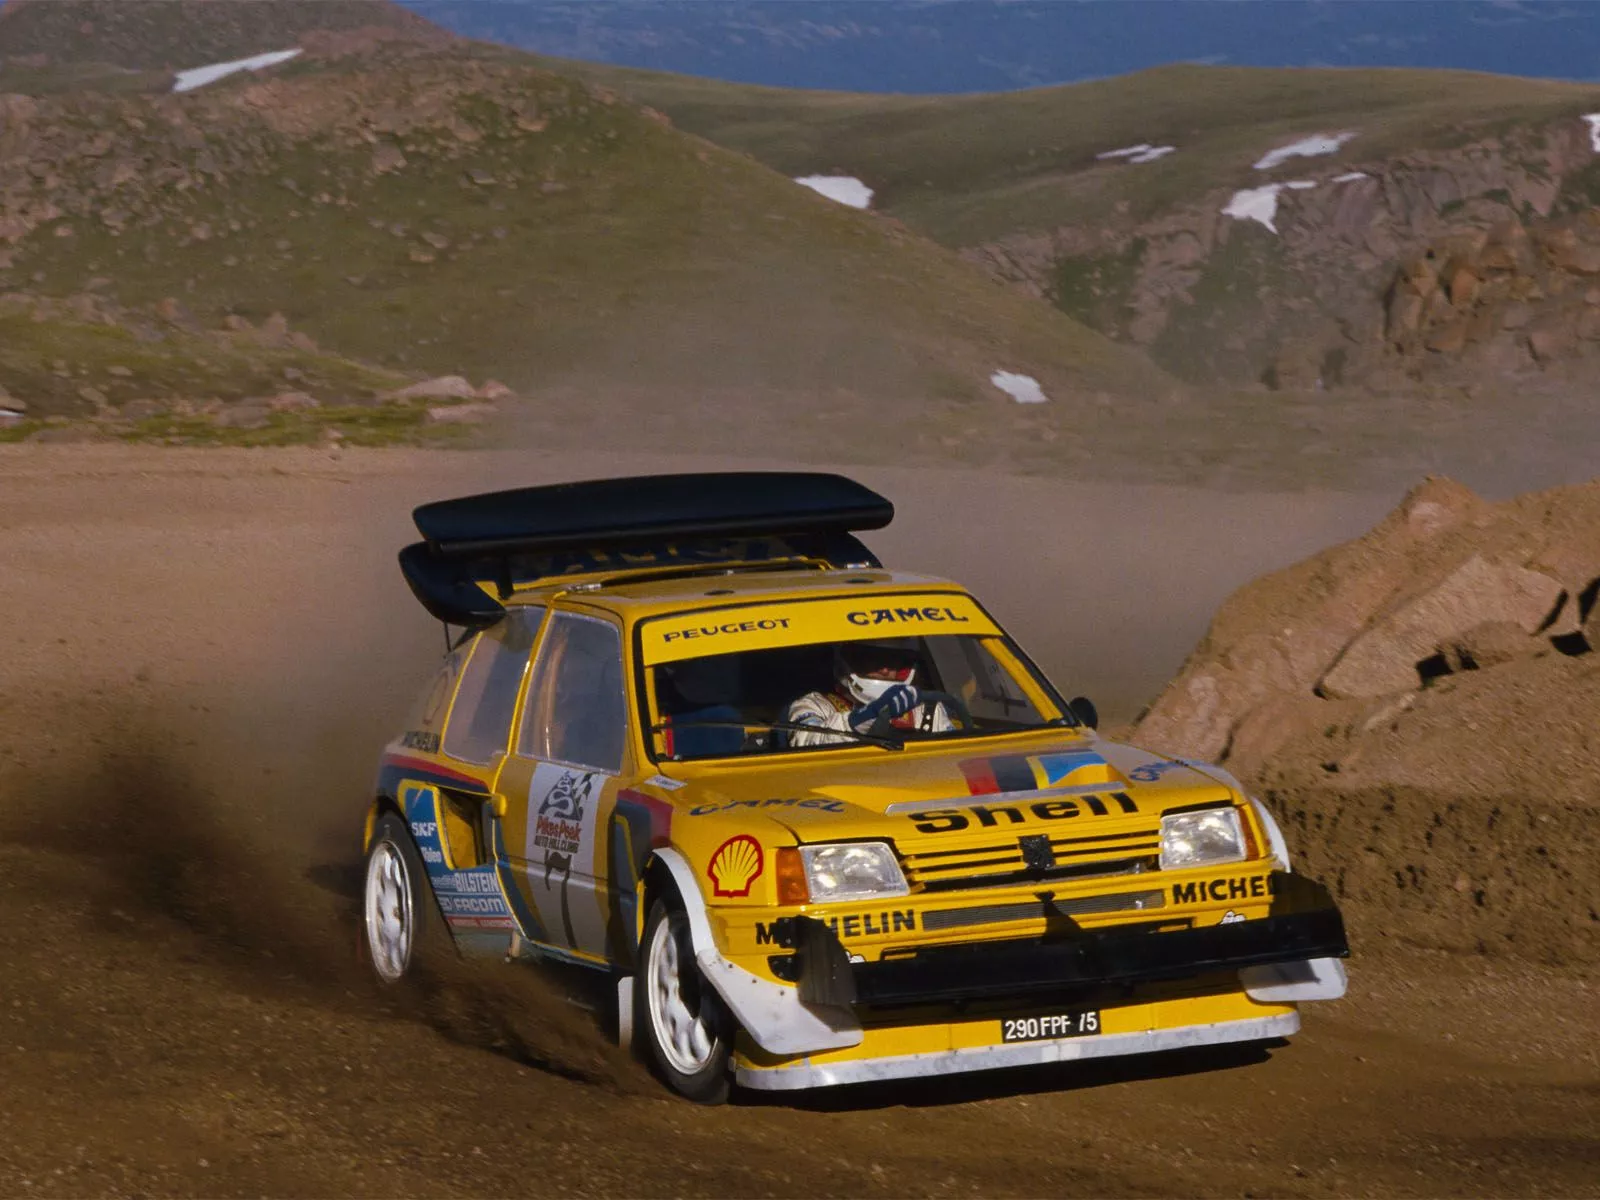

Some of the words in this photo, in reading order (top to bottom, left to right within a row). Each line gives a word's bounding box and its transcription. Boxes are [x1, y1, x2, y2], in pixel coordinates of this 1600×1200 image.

[662, 617, 791, 643] PEUGEOT
[846, 606, 968, 627] CAMEL
[907, 791, 1139, 834] Shell
[411, 822, 437, 837] SKF
[558, 818, 582, 842] Peak
[453, 872, 500, 893] BILSTEIN
[455, 898, 505, 913] FACOM
[1005, 1018, 1038, 1040] 290
[1040, 1015, 1071, 1037] FPF
